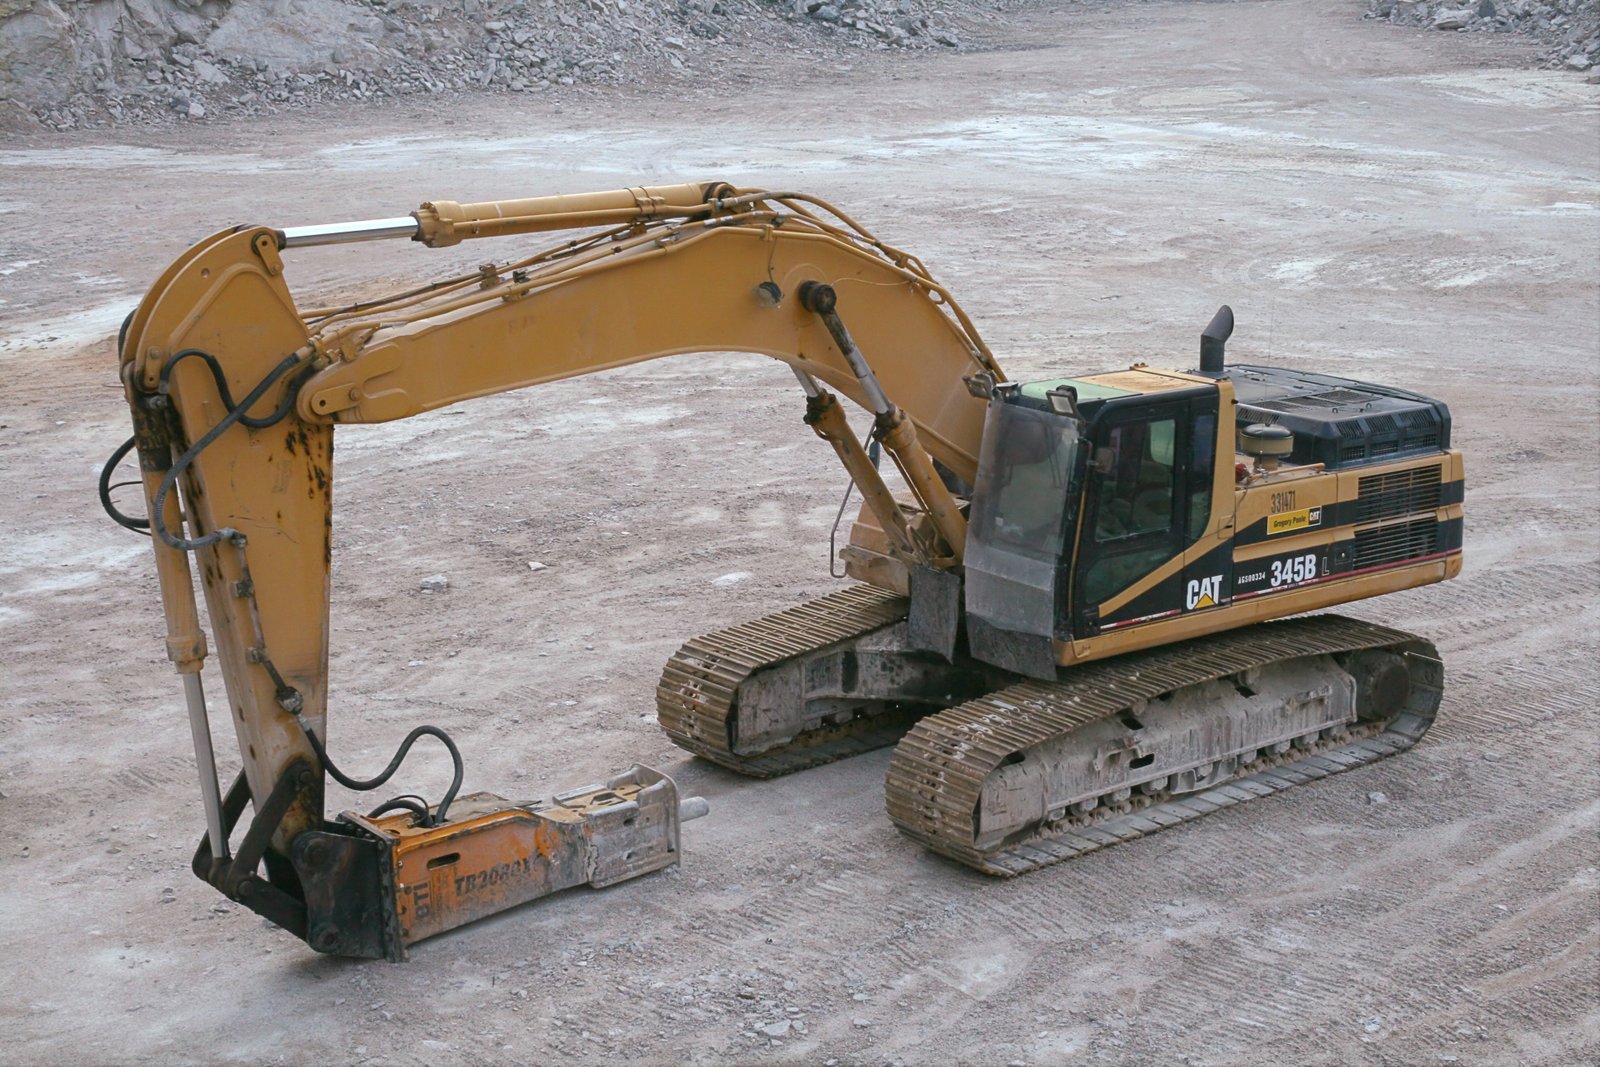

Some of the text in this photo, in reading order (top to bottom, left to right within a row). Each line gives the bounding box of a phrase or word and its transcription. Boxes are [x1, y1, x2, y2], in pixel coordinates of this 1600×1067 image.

[1273, 519, 1292, 528] Gregory
[1309, 511, 1320, 521] CAT
[1271, 554, 1330, 587] 345B L
[1186, 575, 1224, 610] CAT
